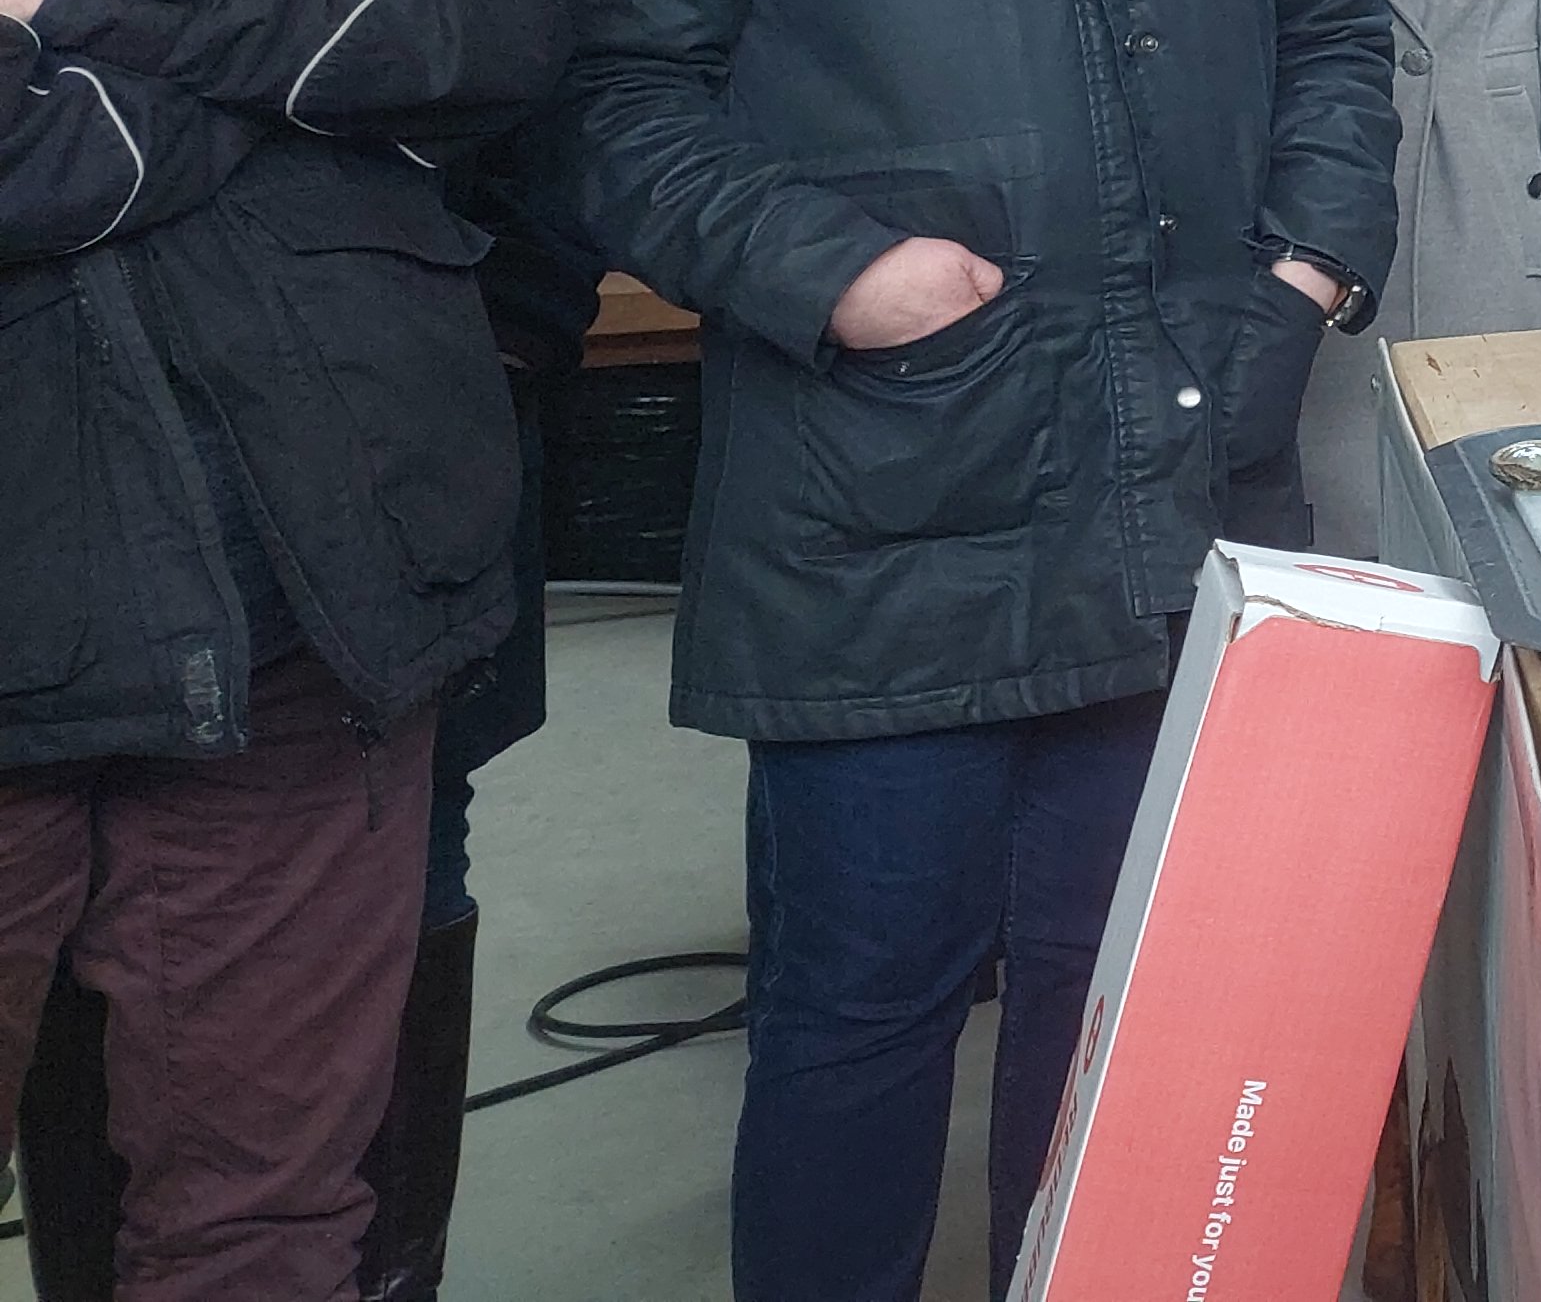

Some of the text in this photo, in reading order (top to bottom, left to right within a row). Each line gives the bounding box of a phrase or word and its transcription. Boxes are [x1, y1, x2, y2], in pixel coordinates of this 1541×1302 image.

[1227, 1079, 1267, 1153] Made
[1218, 1155, 1248, 1206] just
[1202, 1211, 1232, 1251] for
